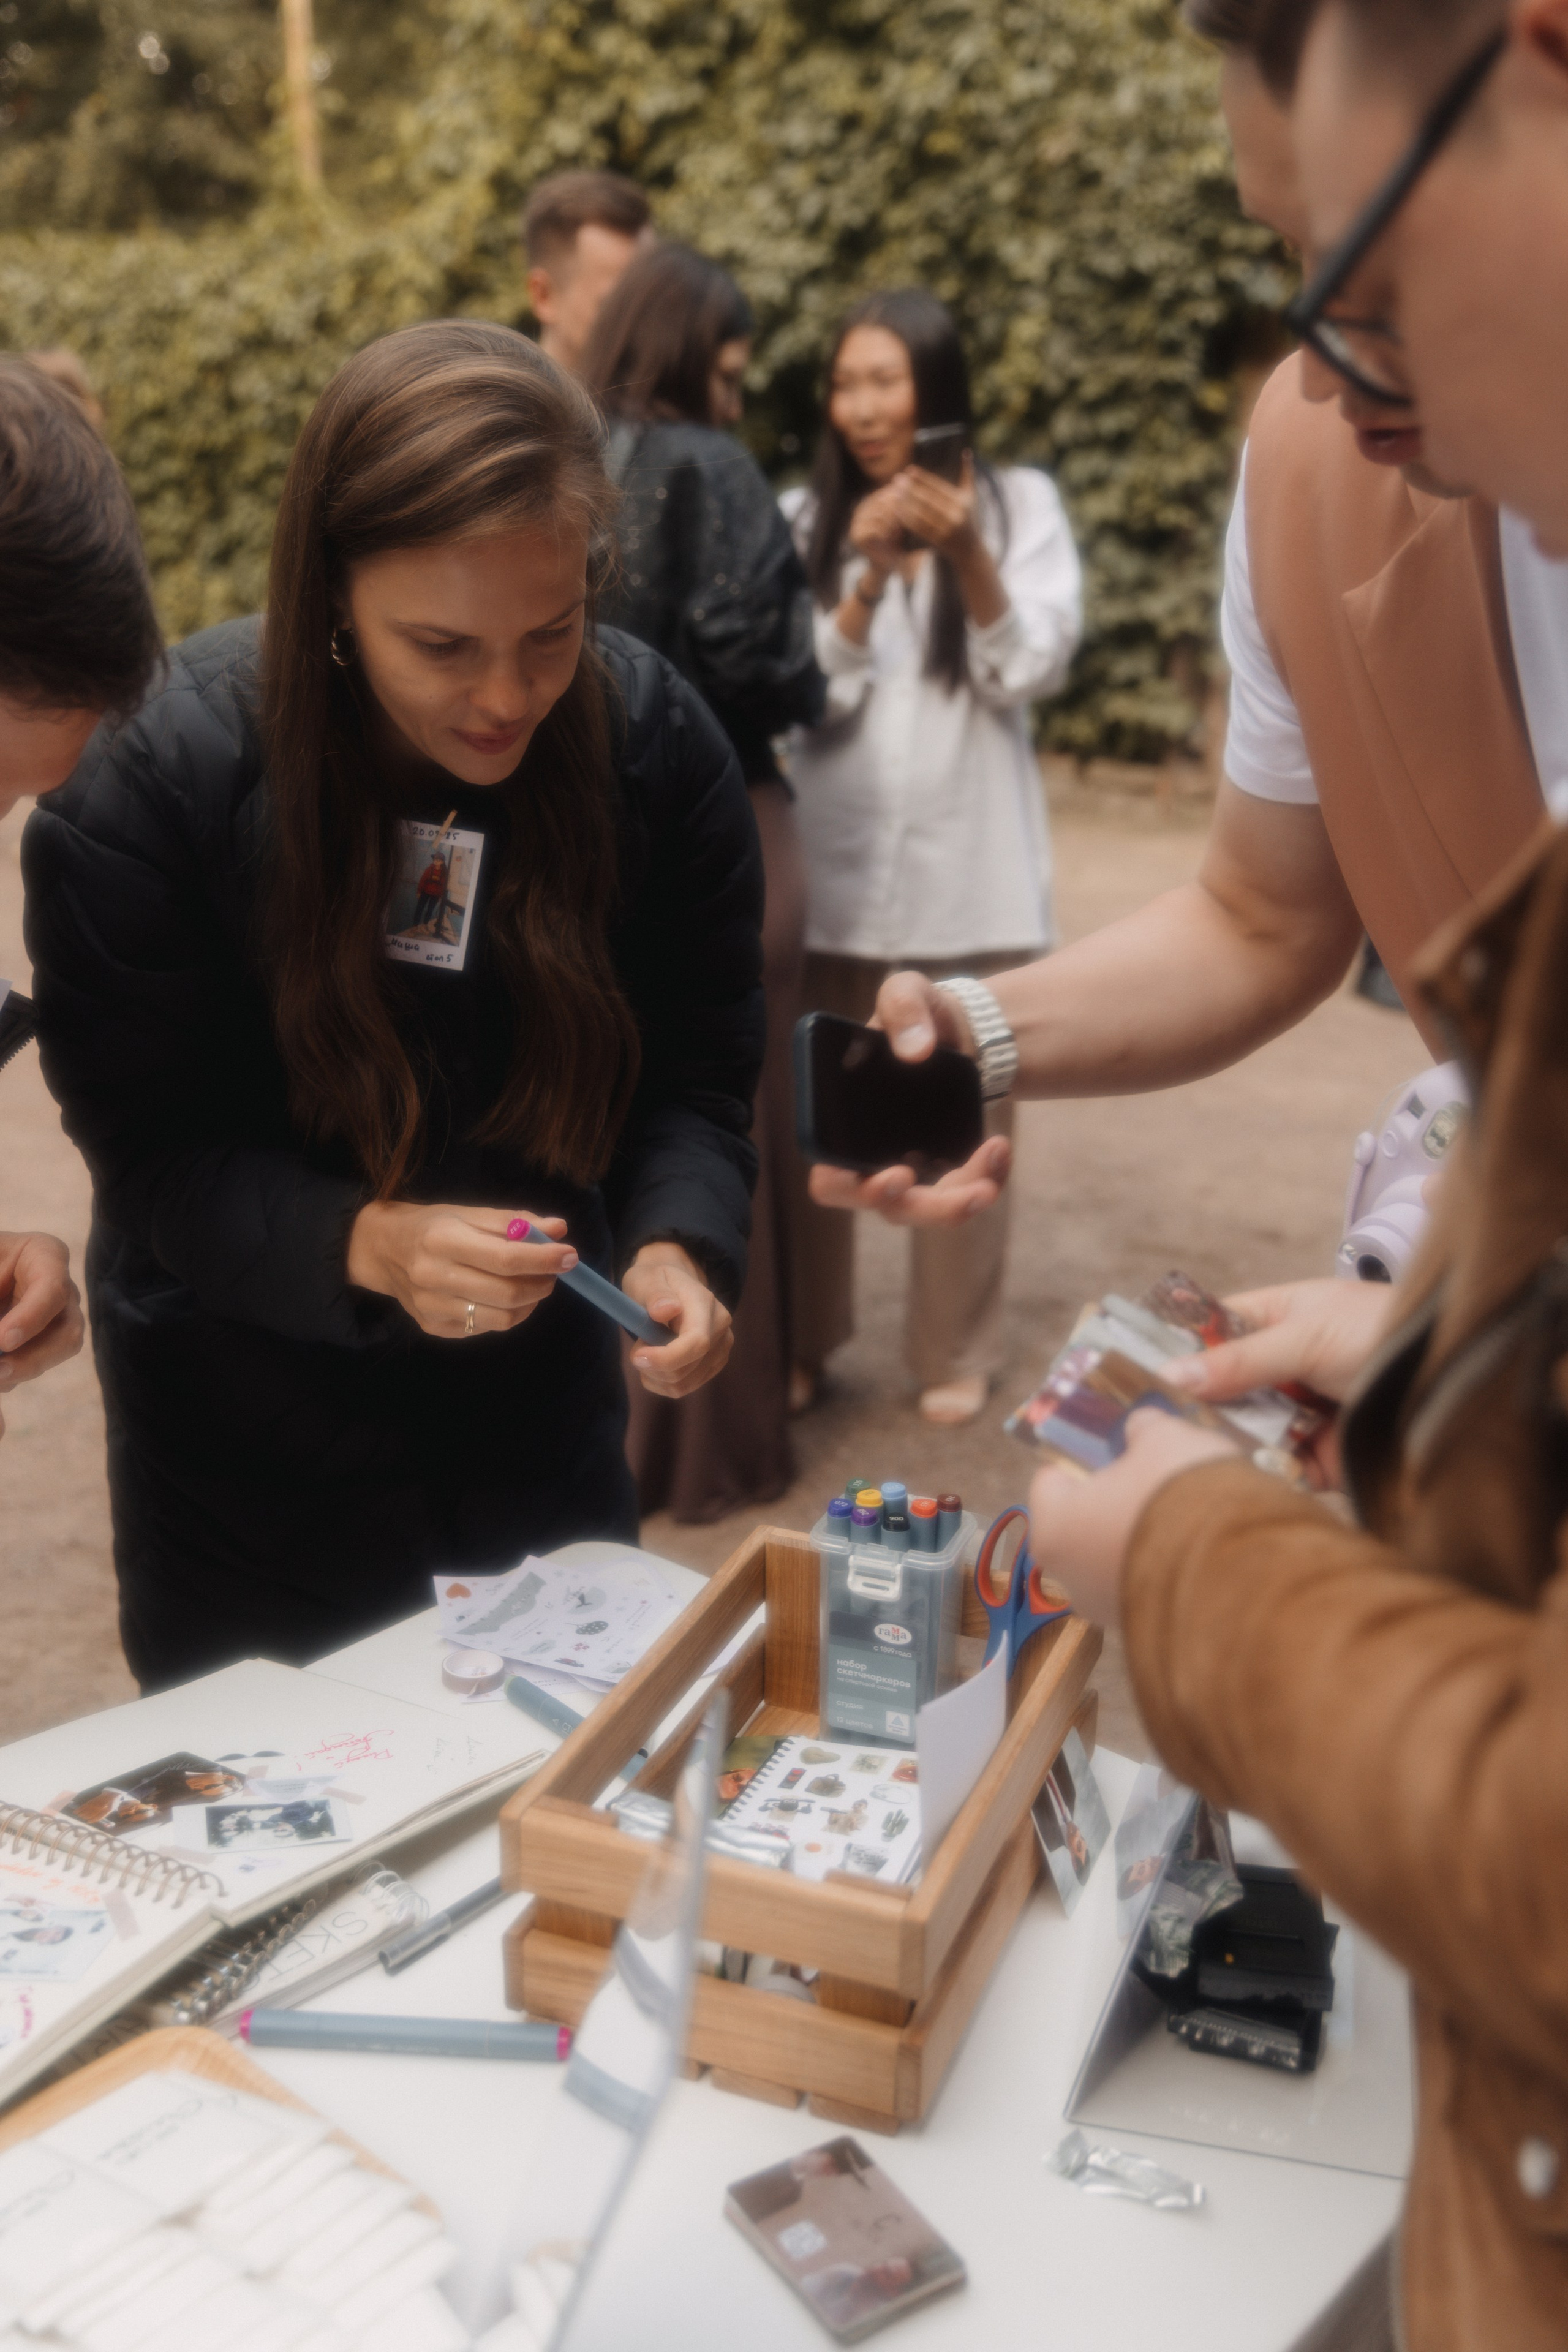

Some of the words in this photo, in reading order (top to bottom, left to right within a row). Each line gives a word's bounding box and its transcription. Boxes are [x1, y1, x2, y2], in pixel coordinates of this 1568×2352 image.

[837, 1659, 867, 1672] набор
[837, 1667, 911, 1688] скетчмаркеров
[836, 1700, 864, 1710] студия
